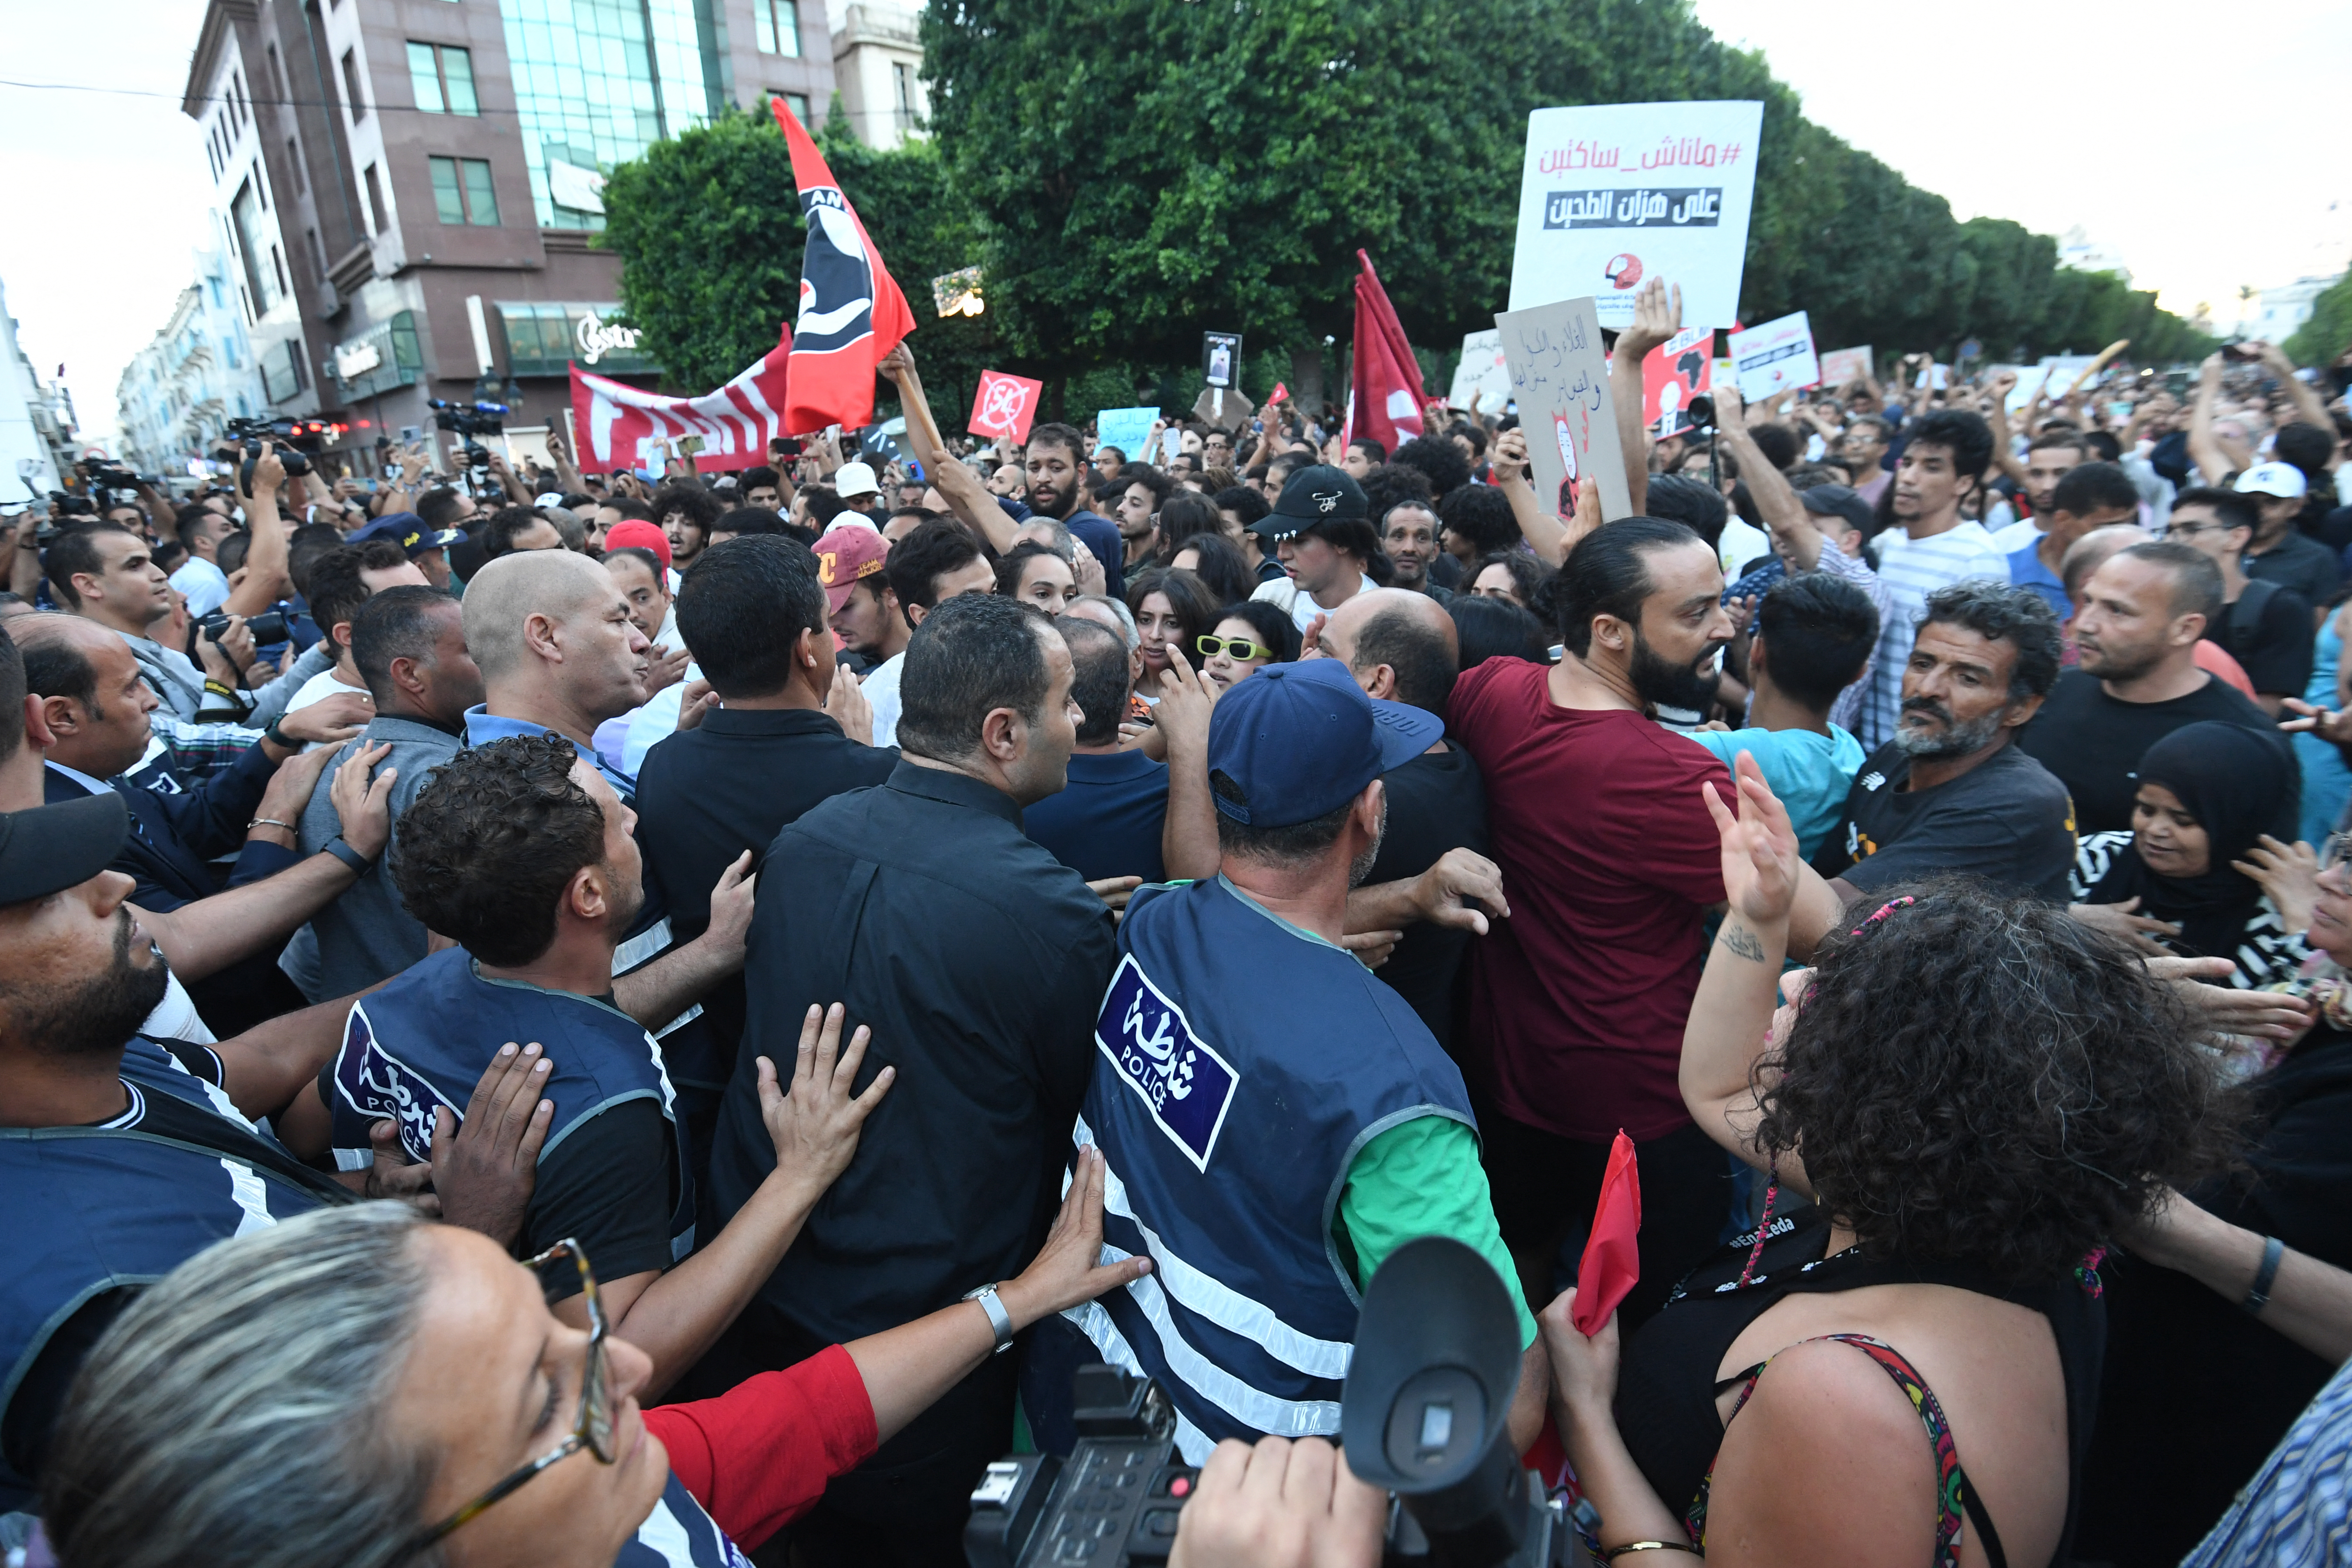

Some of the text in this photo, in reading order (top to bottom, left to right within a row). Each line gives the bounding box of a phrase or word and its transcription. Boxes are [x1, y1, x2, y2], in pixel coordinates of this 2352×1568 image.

[1549, 188, 1719, 228] على هزان الطحين
[816, 552, 837, 584] C
[857, 563, 882, 578] MAJOR
[859, 558, 879, 571] TEAM
[1123, 987, 1196, 1100] شرطة
[1121, 1045, 1167, 1112] POLICE
